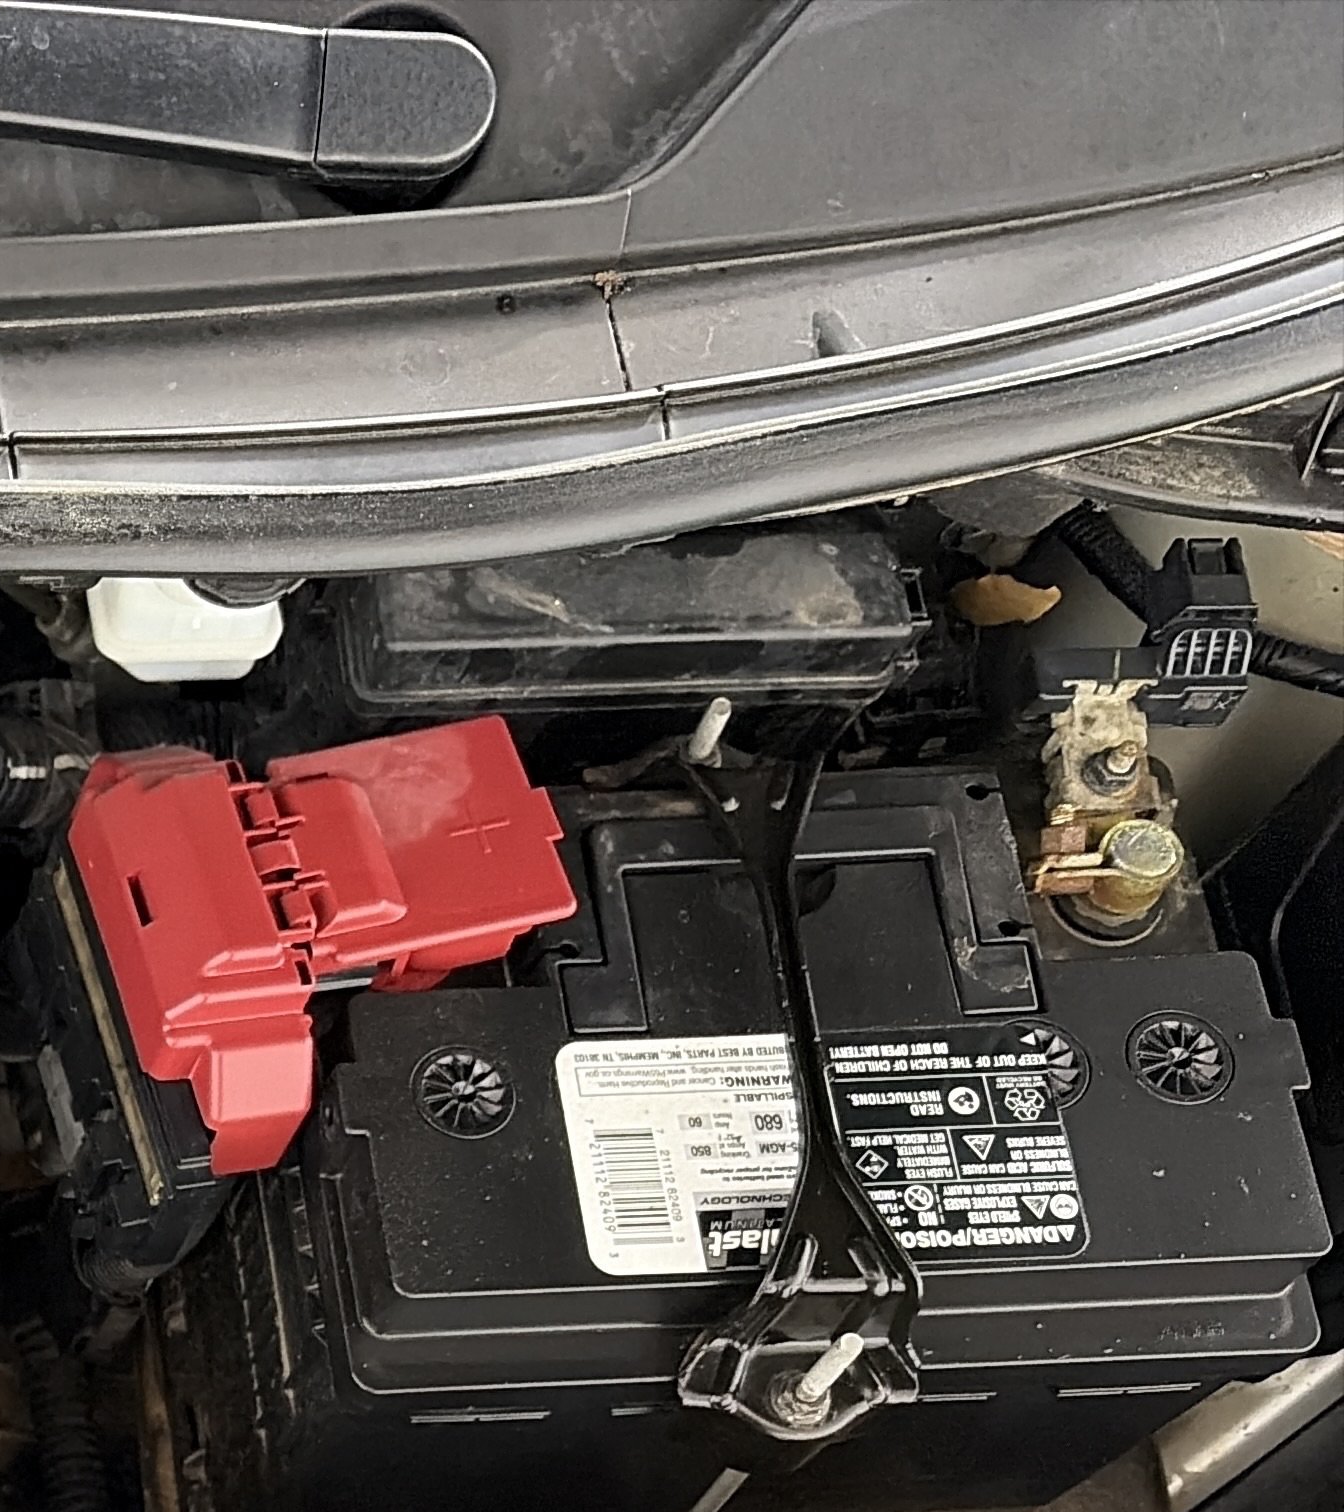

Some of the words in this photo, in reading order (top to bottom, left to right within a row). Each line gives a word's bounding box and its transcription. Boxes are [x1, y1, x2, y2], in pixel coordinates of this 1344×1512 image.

[684, 1048, 715, 1058] PARTS,
[718, 1048, 739, 1057] BEST
[742, 1047, 753, 1056] BY
[881, 1044, 907, 1056] OPEN
[910, 1043, 930, 1054] NOT
[933, 1042, 948, 1053] DO
[574, 1054, 600, 1062] 38103
[602, 1053, 612, 1061] TN
[615, 1050, 658, 1060] MEMPHIS,
[993, 1055, 1016, 1066] OUT
[1018, 1053, 1046, 1066] KEEP
[893, 1060, 906, 1071] OF
[910, 1058, 947, 1071] REACH
[950, 1057, 970, 1068] THE
[975, 1056, 990, 1067] OF
[720, 1075, 792, 1087] WARNING:
[846, 1090, 941, 1103] INSTRUCTIONS.
[910, 1103, 943, 1116] READ
[688, 1116, 702, 1128] 60
[755, 1114, 782, 1132] 680
[872, 1135, 892, 1145] HELP
[892, 1133, 928, 1143] MEDICAL
[929, 1132, 944, 1142] GET
[1035, 1135, 1065, 1146] SEVERE
[691, 1145, 711, 1157] 850
[926, 1144, 947, 1153] WITH
[1024, 1148, 1069, 1158] BLINDNESS
[1010, 1150, 1022, 1159] OR
[896, 1156, 950, 1167] IMMEDIATELY
[1030, 1160, 1072, 1172] SULFURIC
[904, 1169, 925, 1178] EYES
[927, 1168, 953, 1177] FLUSH
[961, 1164, 988, 1175] CAUSE
[989, 1164, 1005, 1174] CAN
[1007, 1162, 1028, 1174] ACID
[588, 1142, 606, 1184] 21112
[598, 1191, 616, 1233] 82409
[659, 1150, 673, 1184] 21112
[667, 1188, 683, 1222] 82409
[973, 1184, 985, 1194] OR
[987, 1183, 1030, 1193] BLINDNESS
[1032, 1181, 1057, 1192] CAUSE
[943, 1197, 971, 1210] GASES
[972, 1196, 1016, 1209] EXPLOSIVE
[918, 1211, 937, 1226] NO
[969, 1211, 990, 1223] EYES
[991, 1210, 1020, 1222] SHIELD
